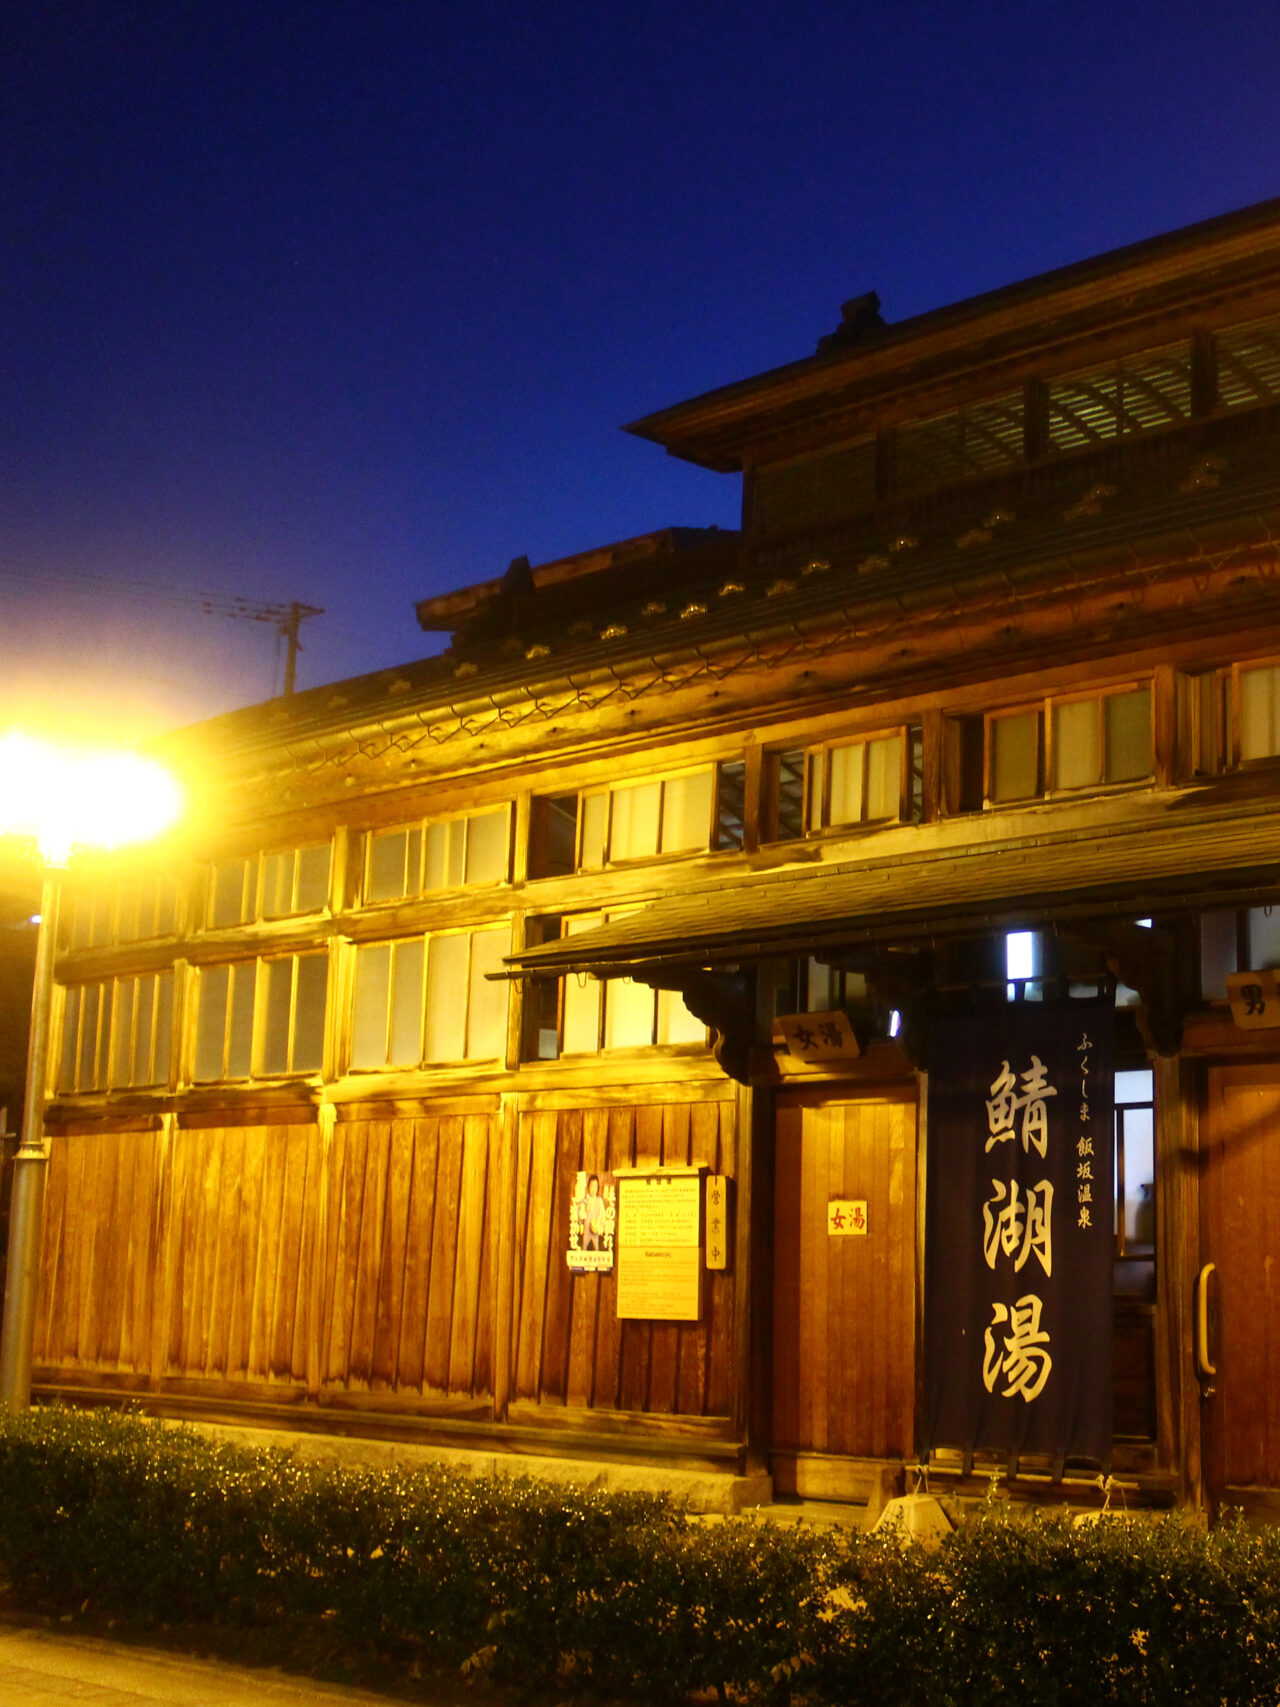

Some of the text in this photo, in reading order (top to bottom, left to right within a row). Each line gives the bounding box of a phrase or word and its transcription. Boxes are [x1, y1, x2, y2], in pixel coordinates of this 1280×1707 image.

[793, 1021, 844, 1050] 女湯
[1076, 1032, 1095, 1229] ふくしま 飯坂温泉
[711, 1189, 721, 1263] 営業中
[830, 1205, 867, 1232] 女湯
[982, 1055, 1058, 1403] 鯖湖湯
